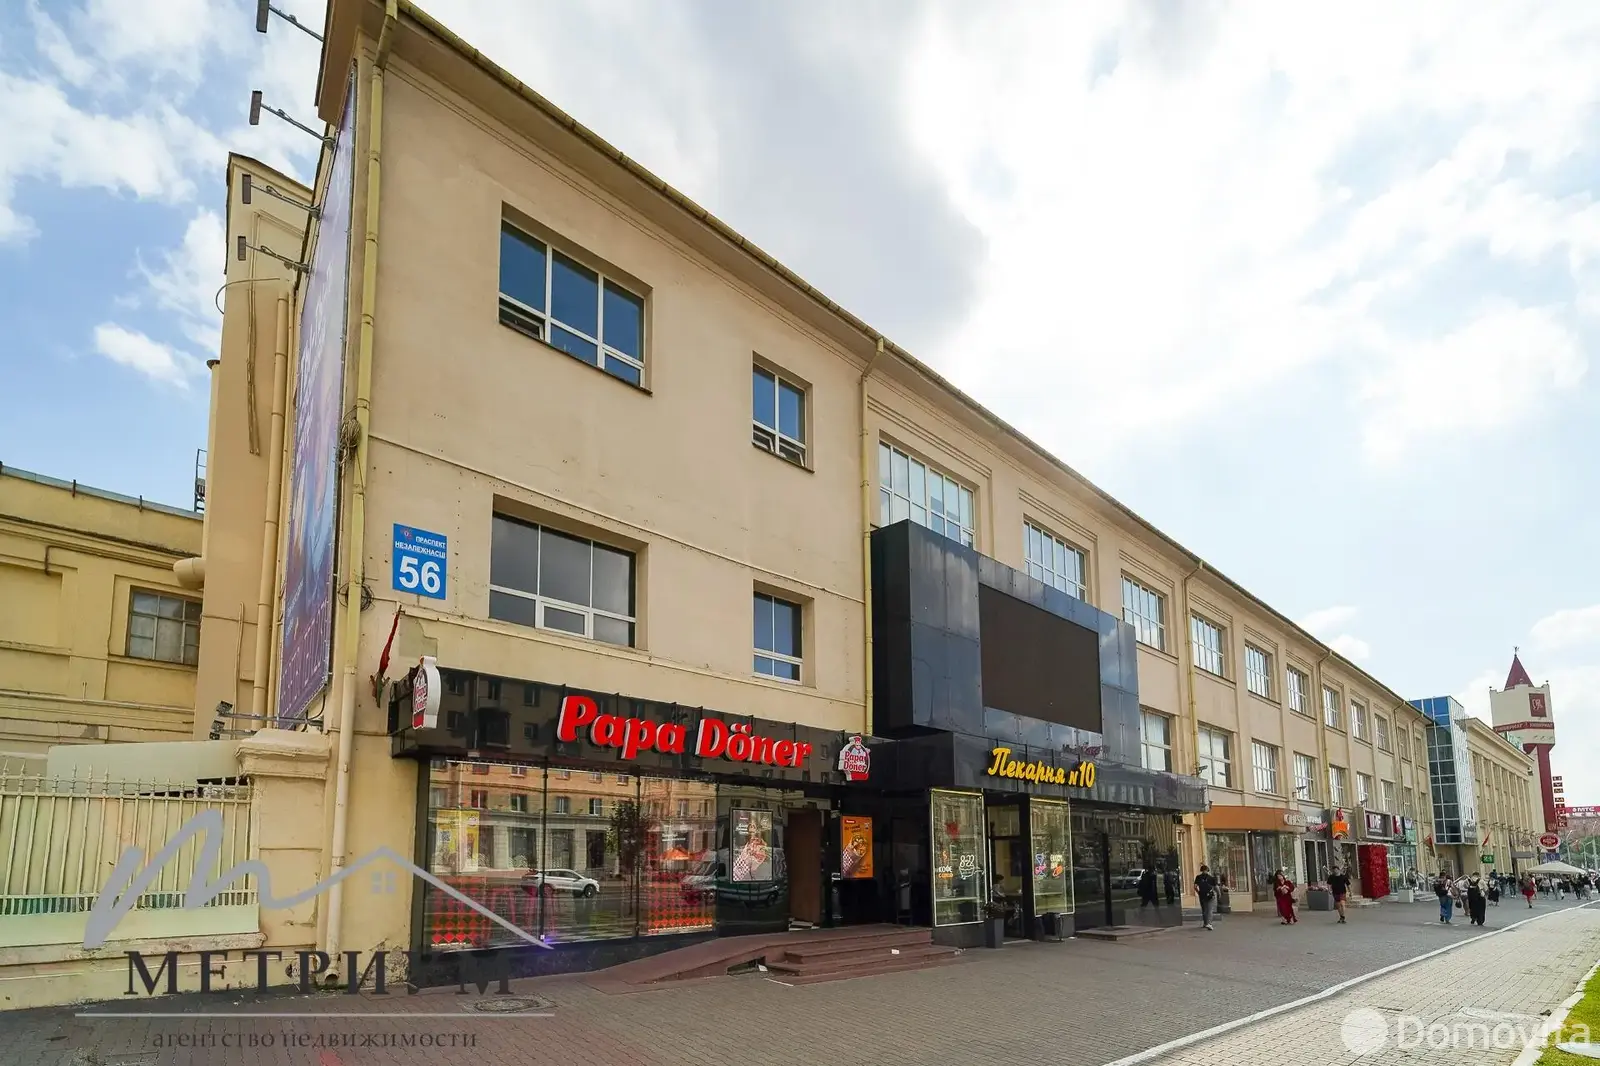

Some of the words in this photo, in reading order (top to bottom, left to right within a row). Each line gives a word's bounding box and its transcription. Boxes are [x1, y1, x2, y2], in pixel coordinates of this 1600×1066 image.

[415, 536, 446, 549] ПРАСПЕКТ
[399, 555, 441, 594] 56
[557, 695, 687, 760] Papa
[695, 718, 813, 768] Döner
[843, 760, 867, 771] Döner
[844, 751, 867, 763] Papa
[988, 747, 1065, 784] Пекарня
